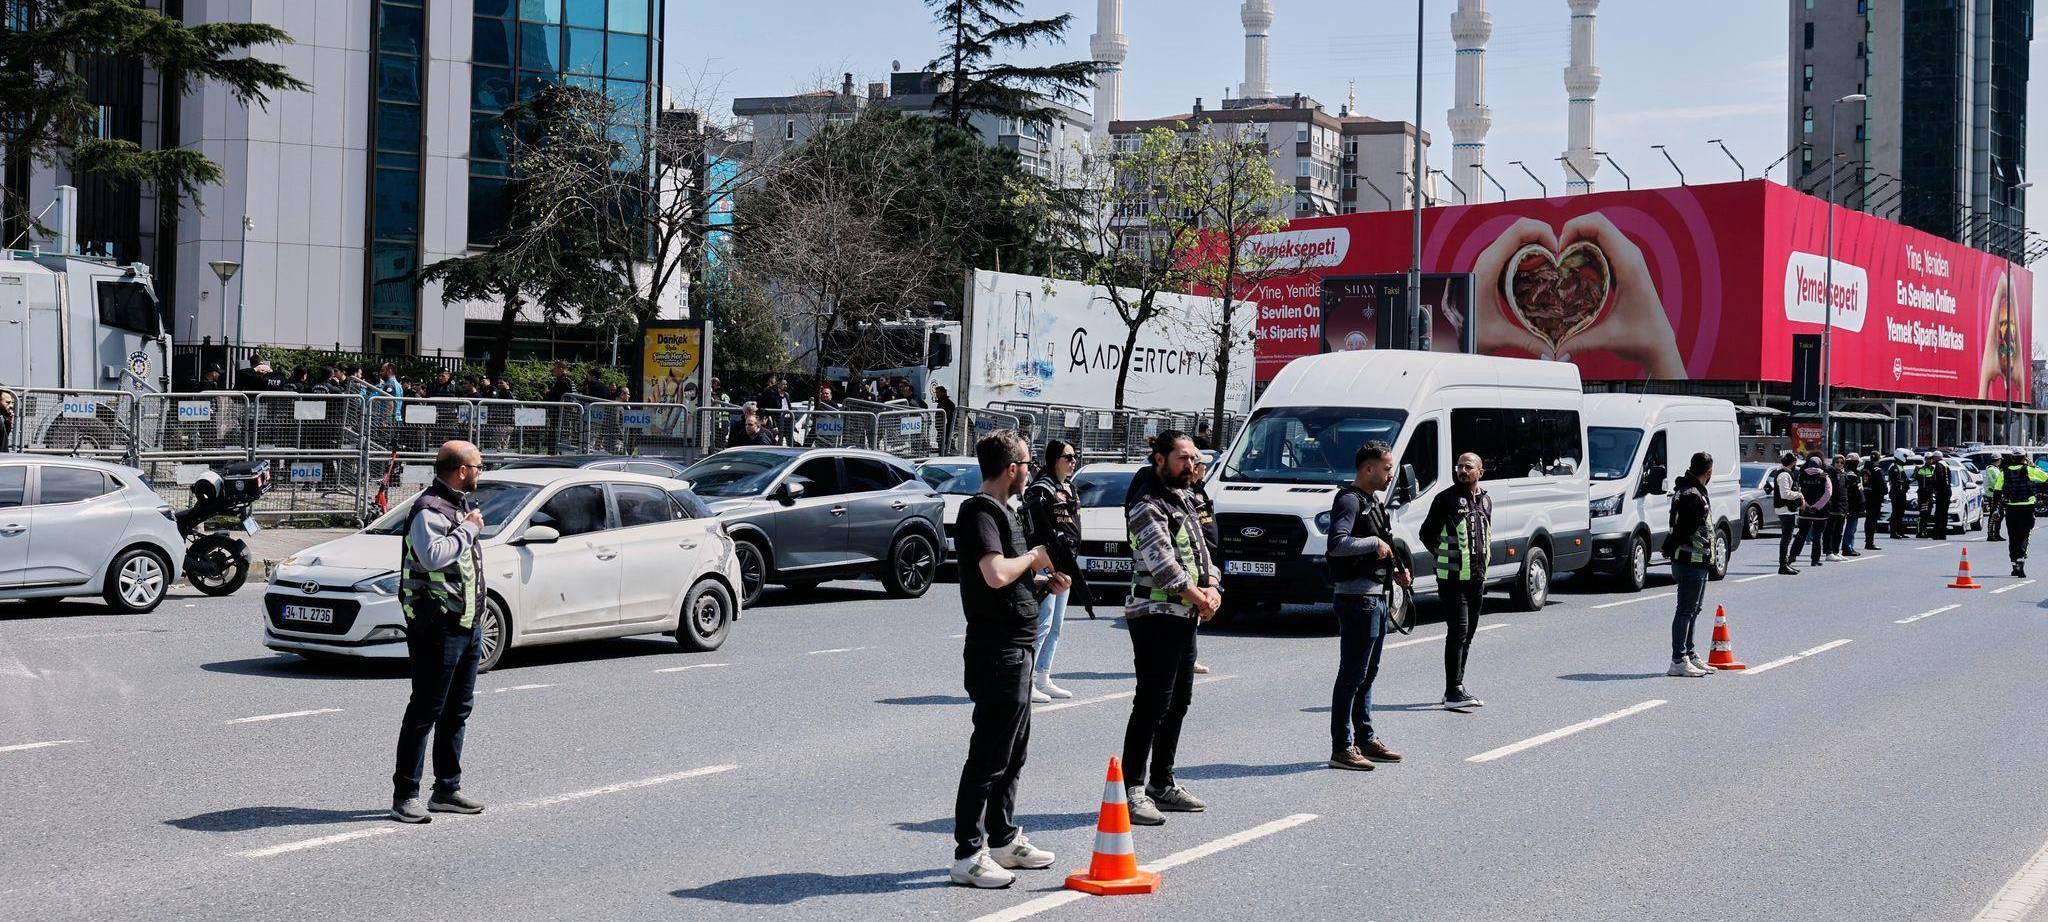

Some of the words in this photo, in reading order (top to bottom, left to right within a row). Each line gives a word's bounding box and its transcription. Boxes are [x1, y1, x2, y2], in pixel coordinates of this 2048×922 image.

[1906, 244, 1924, 277] Yine,
[1924, 249, 1949, 278] Yeniden
[1259, 285, 1284, 301] Yine,
[1286, 283, 1320, 297] Yenide
[1384, 286, 1400, 295] Taksi
[1897, 280, 1907, 306] En
[1908, 282, 1935, 311] Sevilen
[1935, 288, 1956, 315] Online
[1262, 304, 1302, 319] Sevilen
[1270, 324, 1308, 343] Sipariş
[1887, 315, 1913, 345] Yemek
[1913, 320, 1938, 354] Sipariş
[1938, 325, 1964, 351] Markası
[657, 334, 688, 345] Dankek
[64, 402, 95, 414] POLİS
[179, 405, 210, 416] POLİS
[624, 413, 651, 424] POLİS
[816, 421, 843, 433] POLİS
[901, 420, 921, 431] POLİS
[292, 467, 321, 478] POLİS
[1104, 542, 1119, 553] FIAT
[1092, 560, 1100, 569] 34
[1230, 562, 1238, 571] 34
[1242, 562, 1252, 572] ED
[286, 606, 295, 618] 34
[299, 607, 308, 620] TL
[311, 608, 331, 621] 2736
